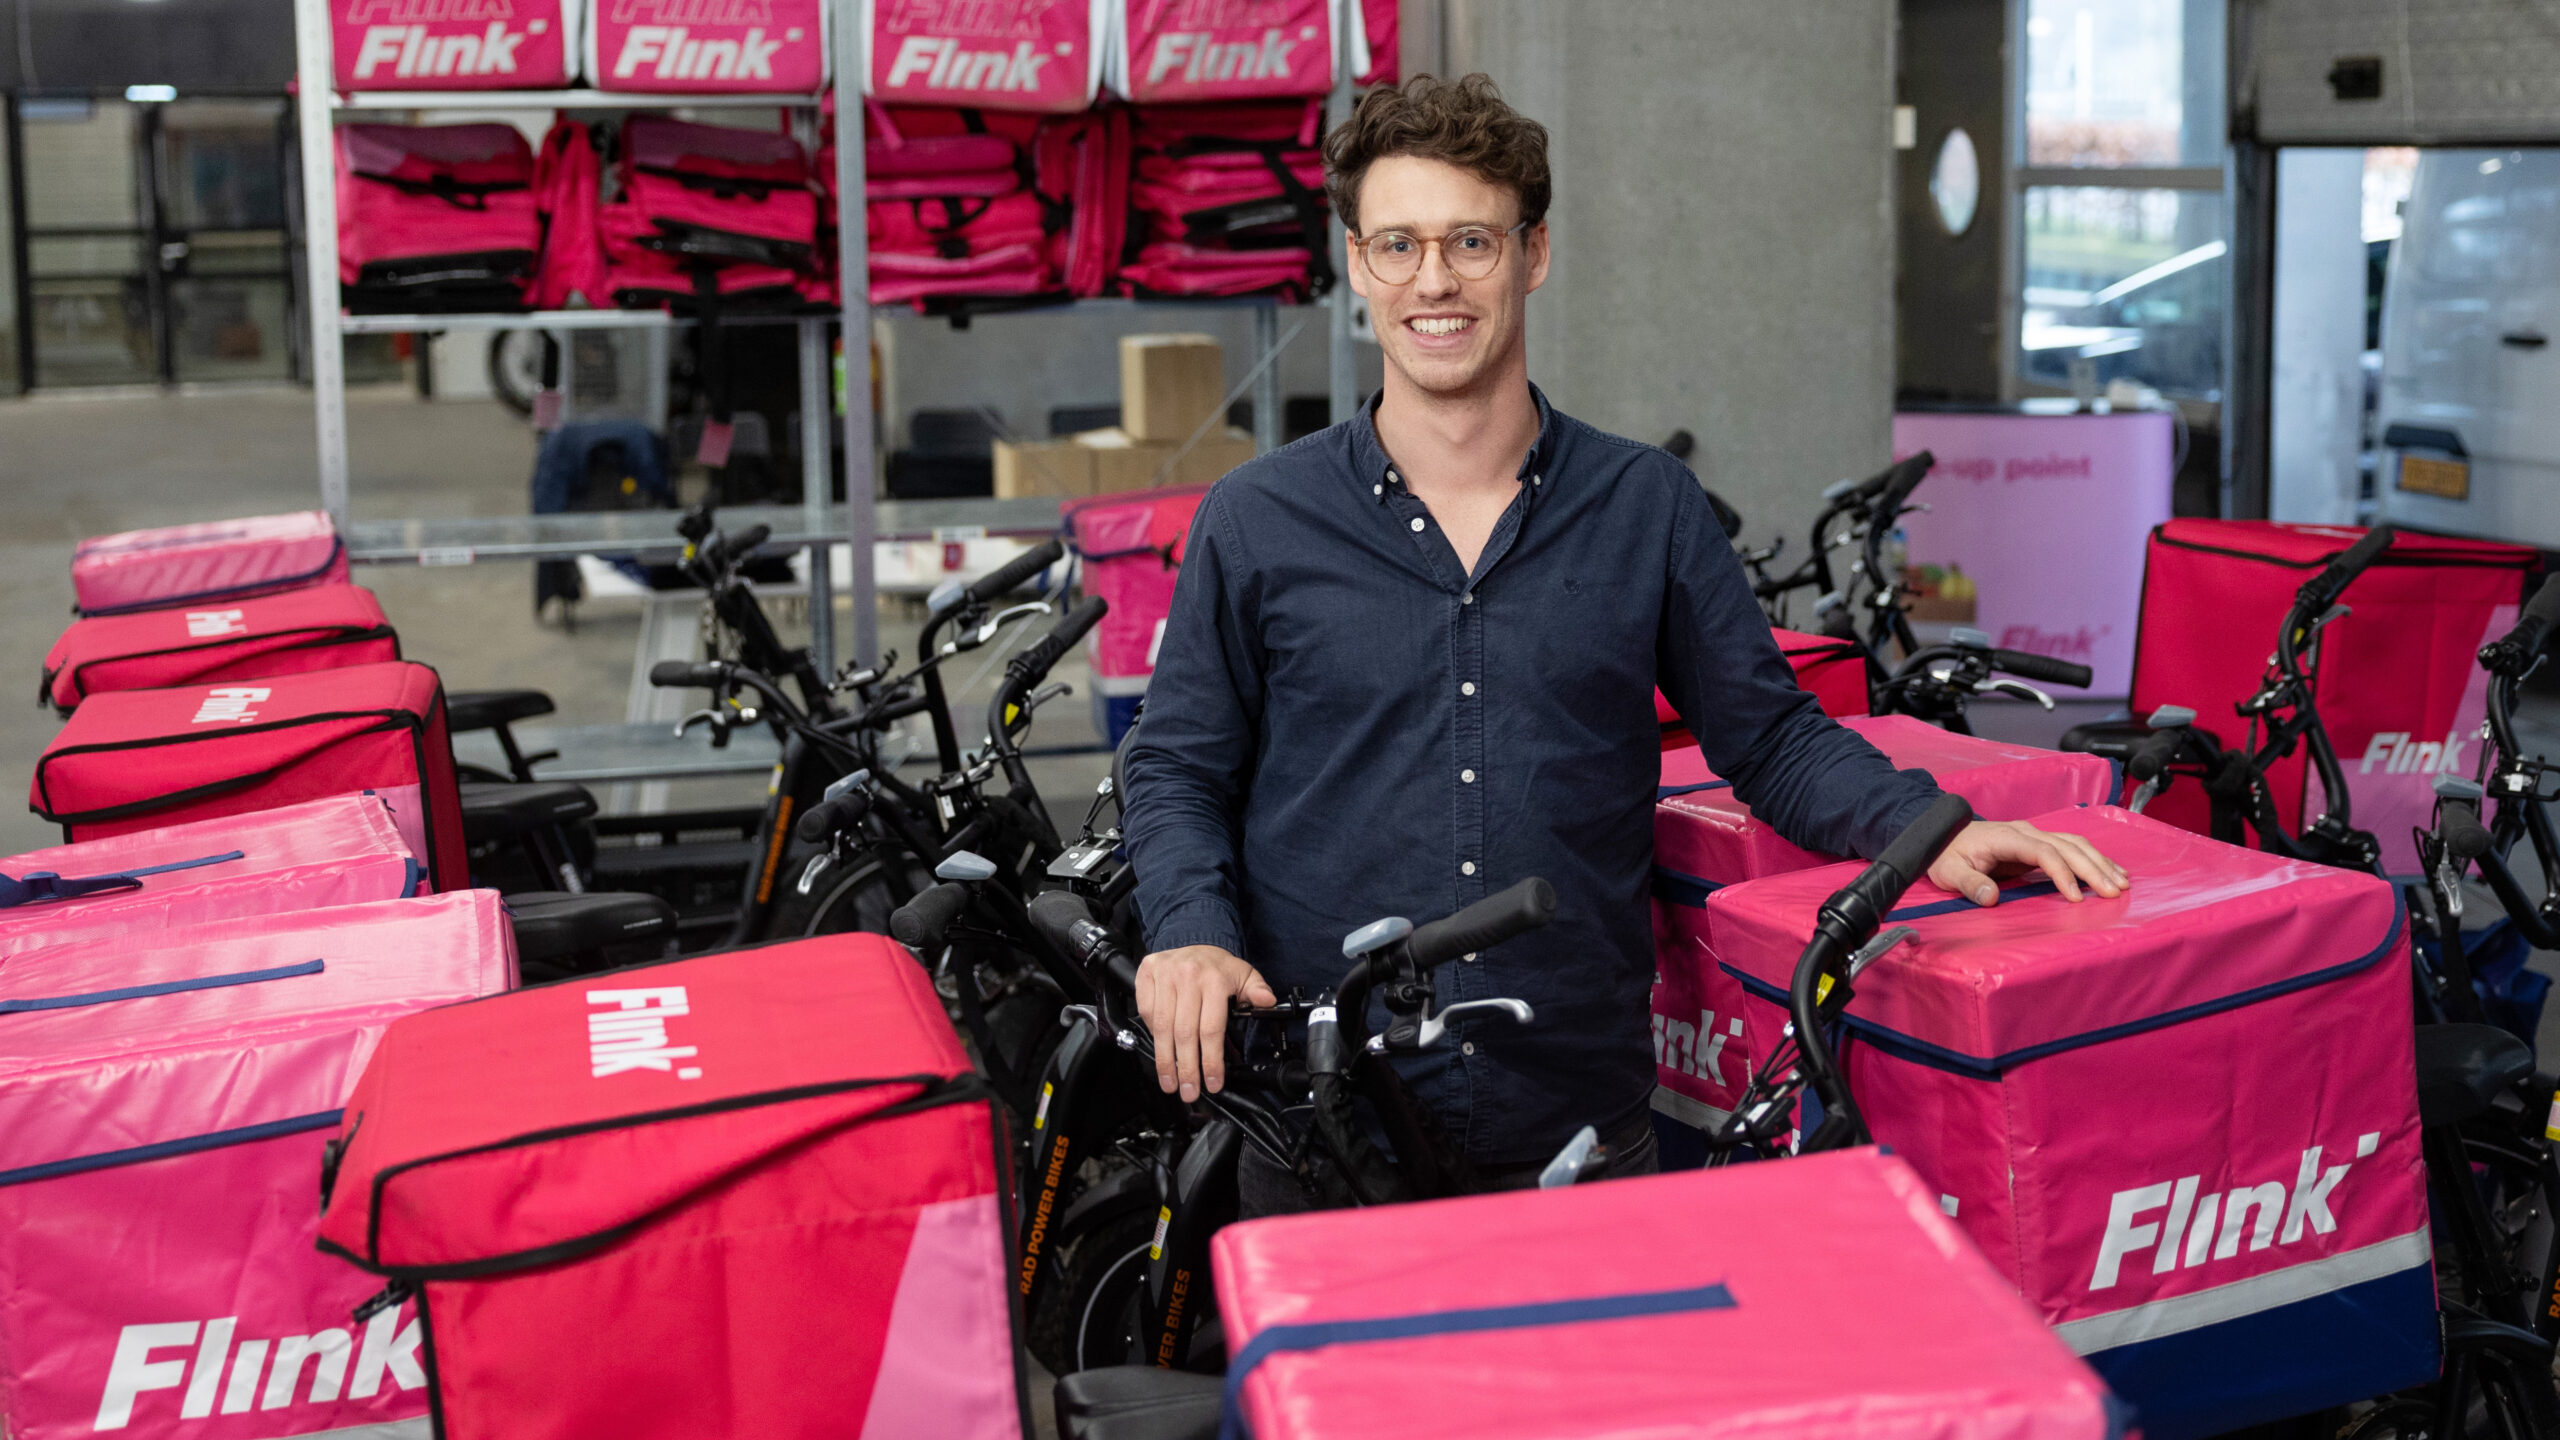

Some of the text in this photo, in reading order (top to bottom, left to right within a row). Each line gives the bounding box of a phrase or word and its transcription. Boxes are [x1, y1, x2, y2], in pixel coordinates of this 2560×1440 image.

[353, 19, 547, 80] Flink
[613, 25, 804, 80] Flink
[886, 36, 1073, 92] Flink
[1147, 26, 1317, 84] Flink
[2360, 730, 2481, 775] Flink
[586, 985, 703, 1080] Flink
[1650, 1008, 1744, 1088] ink
[1044, 1134, 1070, 1188] BIKES
[1027, 1188, 1057, 1255] POWER
[2088, 1131, 2381, 1292] Flink
[1020, 1255, 1038, 1296] RAD
[1165, 1268, 1191, 1329] BIKES
[93, 1303, 428, 1431] Flink
